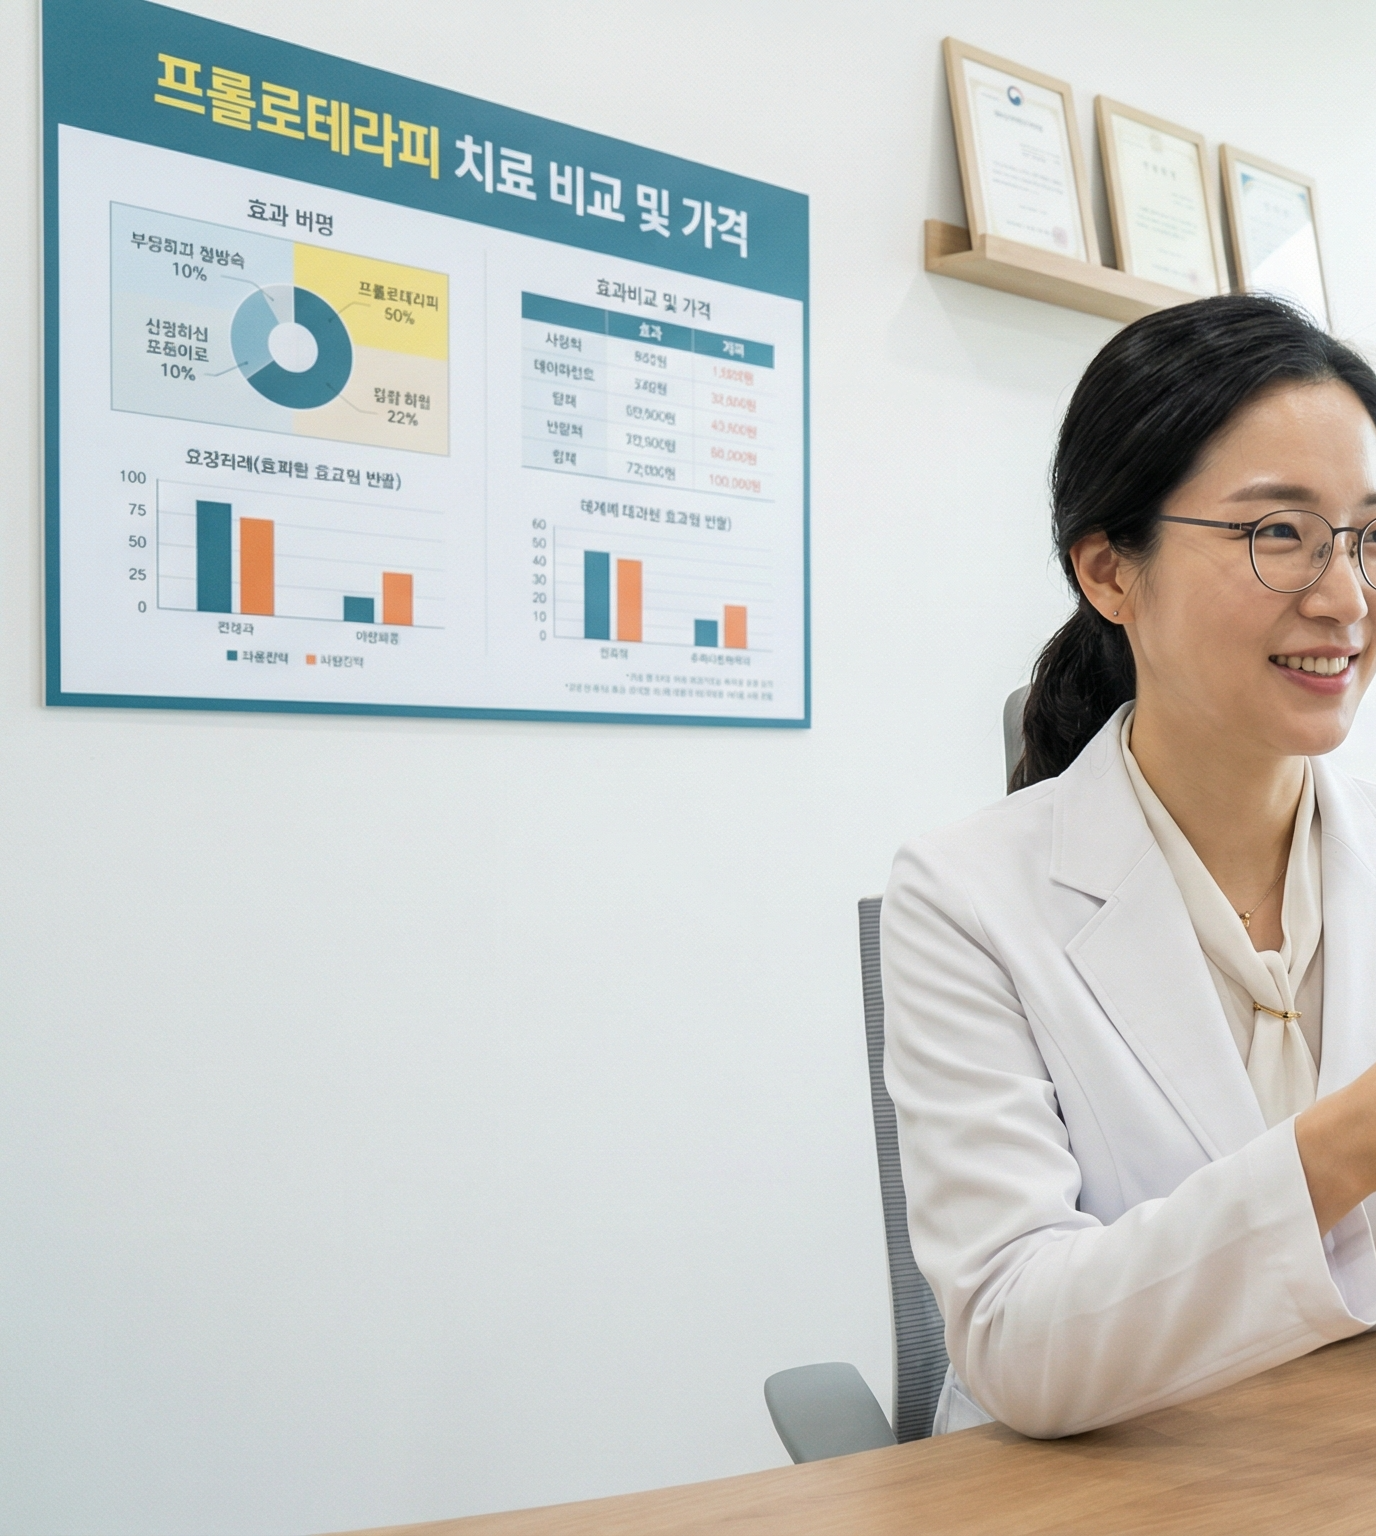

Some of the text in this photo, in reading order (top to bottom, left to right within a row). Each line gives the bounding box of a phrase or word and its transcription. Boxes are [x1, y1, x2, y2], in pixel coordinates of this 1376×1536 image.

[154, 52, 749, 259] 프롤로테라피 치료 비교 및 가격
[247, 198, 289, 228] 효과
[172, 261, 208, 282] 10%
[596, 278, 711, 321] 효과비교 및 가격
[384, 306, 415, 325] 50%
[160, 363, 196, 382] 10%
[387, 409, 419, 427] 22%
[119, 470, 147, 485] 100
[129, 503, 147, 517] 75
[532, 518, 547, 531] 60
[129, 535, 147, 549] 50
[532, 537, 547, 549] 50
[532, 555, 547, 567] 40
[129, 568, 147, 582] 25
[532, 574, 547, 586] 30
[532, 592, 547, 604] 20
[137, 601, 147, 613] 0
[533, 611, 547, 623] 10
[539, 630, 547, 641] 0
